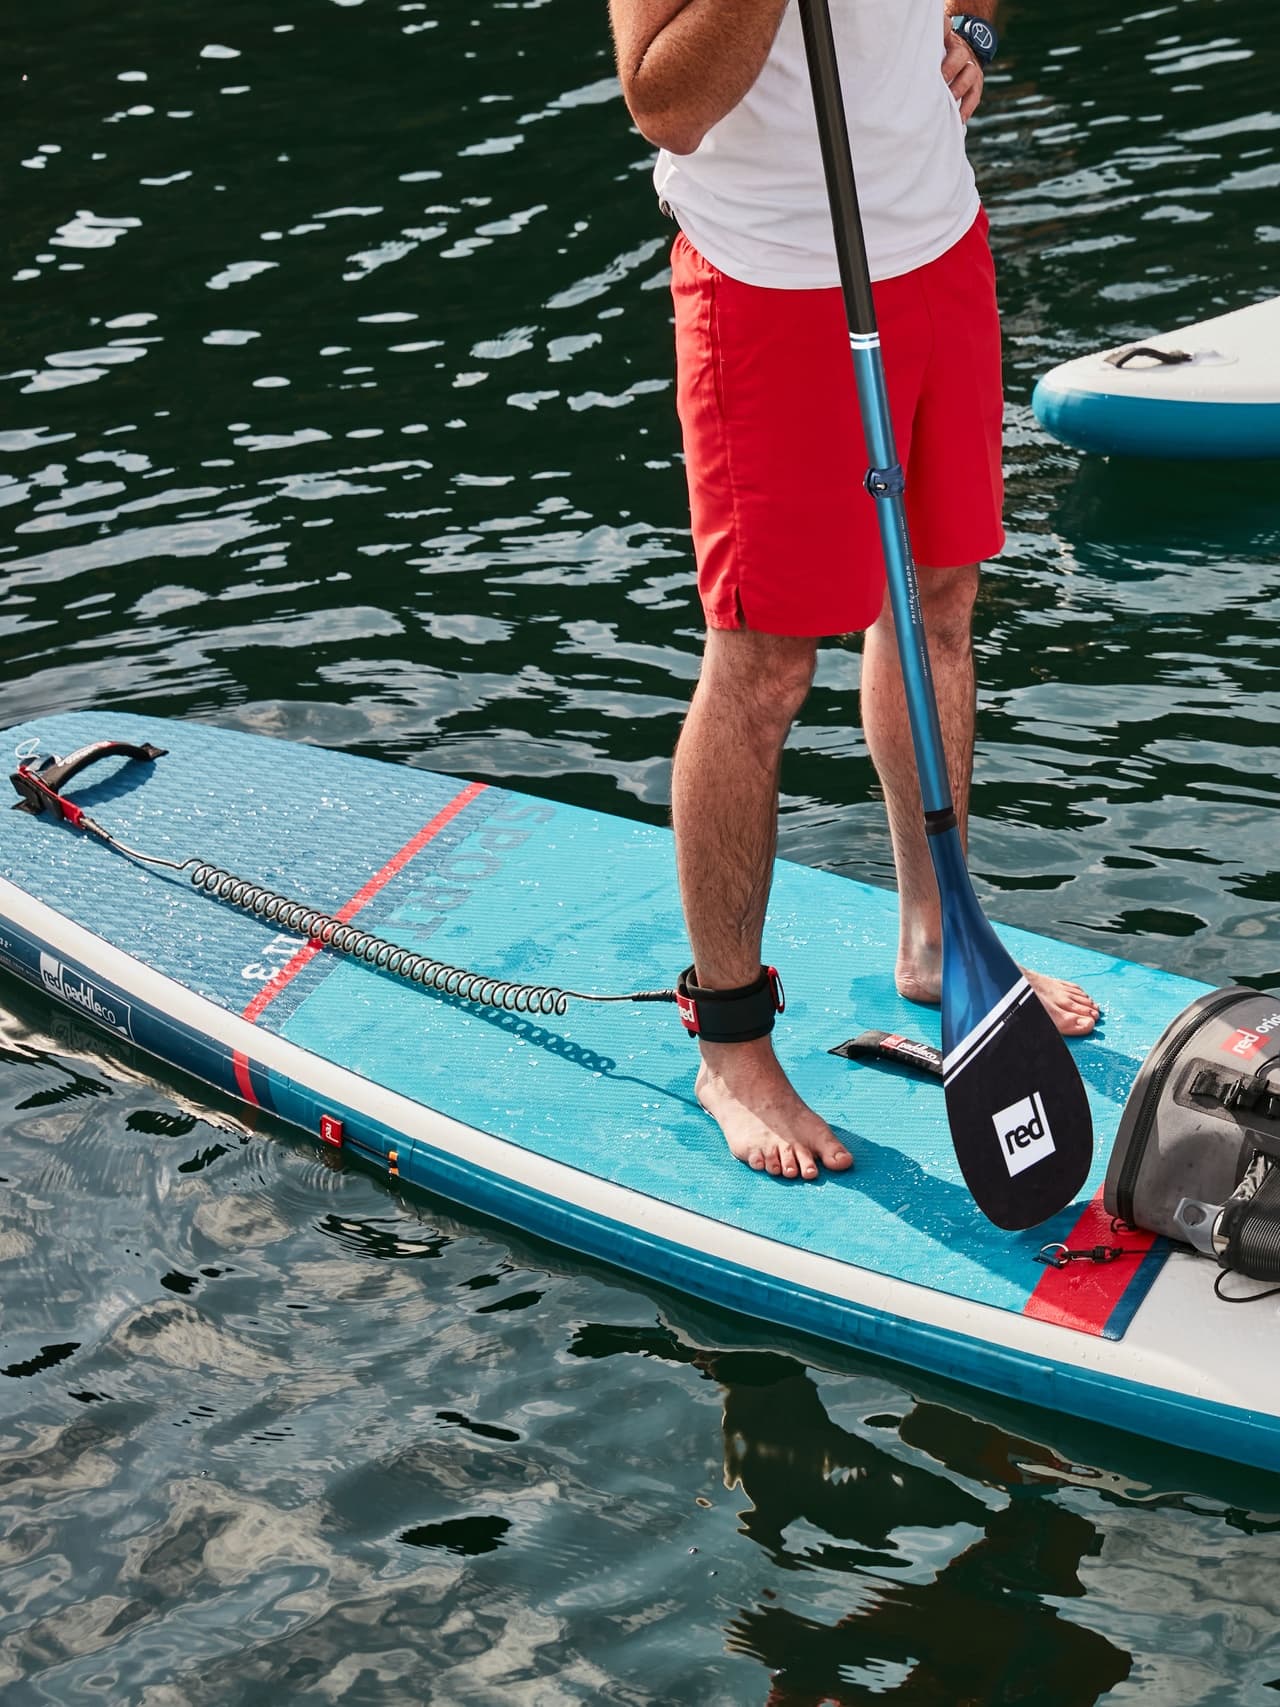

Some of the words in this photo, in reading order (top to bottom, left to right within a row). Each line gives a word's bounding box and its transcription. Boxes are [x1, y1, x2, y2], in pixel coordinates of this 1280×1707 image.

[380, 800, 557, 942] SPORT
[43, 962, 61, 988] red
[1232, 1029, 1260, 1055] red
[1005, 1094, 1045, 1156] red
